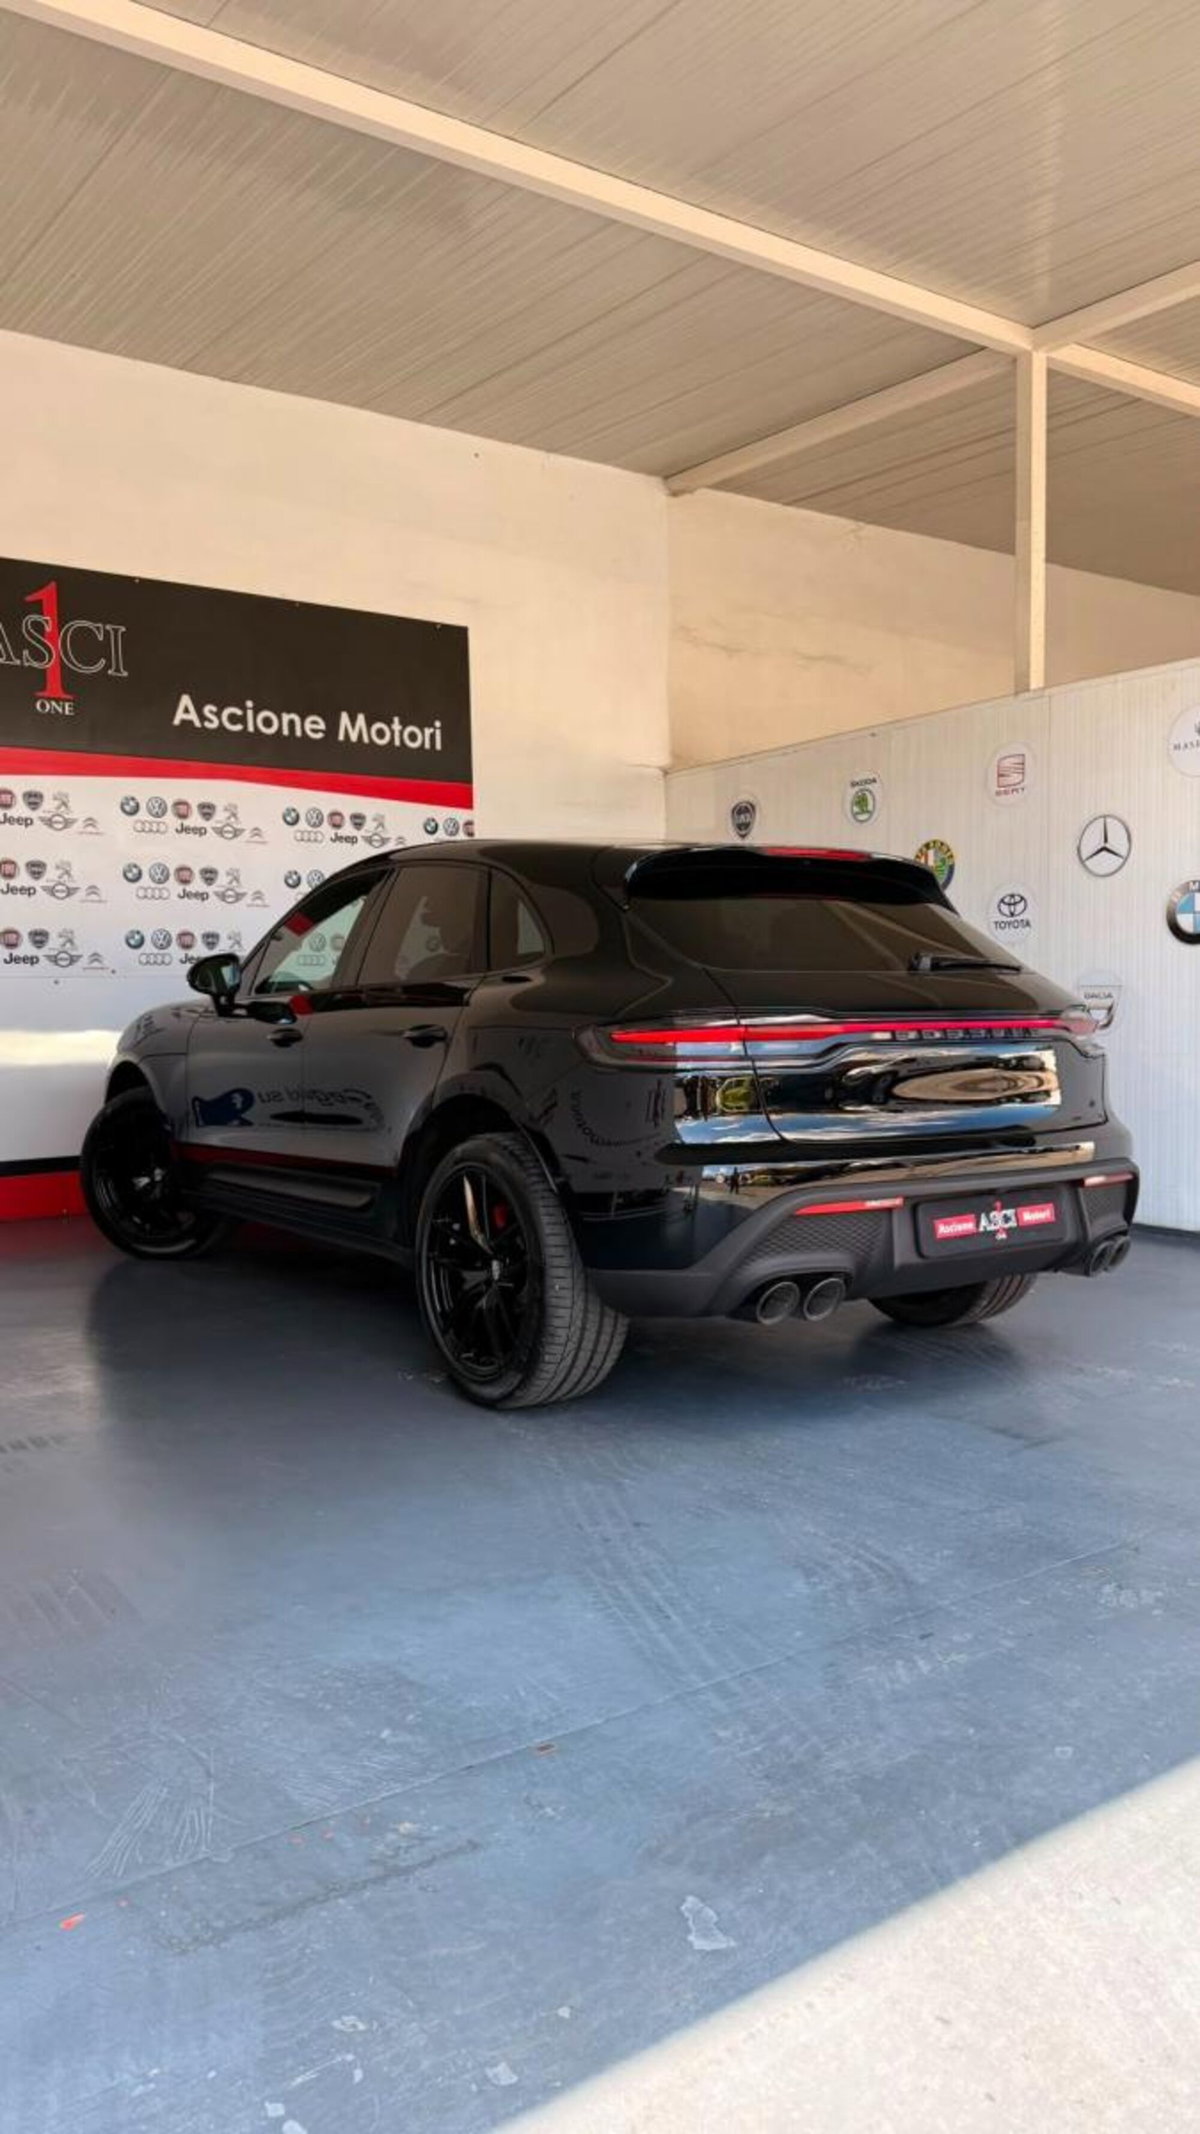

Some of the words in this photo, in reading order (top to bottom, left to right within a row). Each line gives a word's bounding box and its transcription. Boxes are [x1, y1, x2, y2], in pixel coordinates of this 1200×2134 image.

[35, 699, 76, 716] ONE
[173, 693, 326, 739] Ascione
[338, 711, 442, 750] Motori
[0, 812, 34, 829] Jeep
[175, 822, 208, 837] Jeep
[330, 832, 359, 846] Jeep
[1, 882, 37, 898] Jeep
[177, 887, 210, 902] Jeep
[994, 918, 1032, 931] TOYOTA
[3, 952, 40, 967] Jeep
[179, 953, 201, 965] Je
